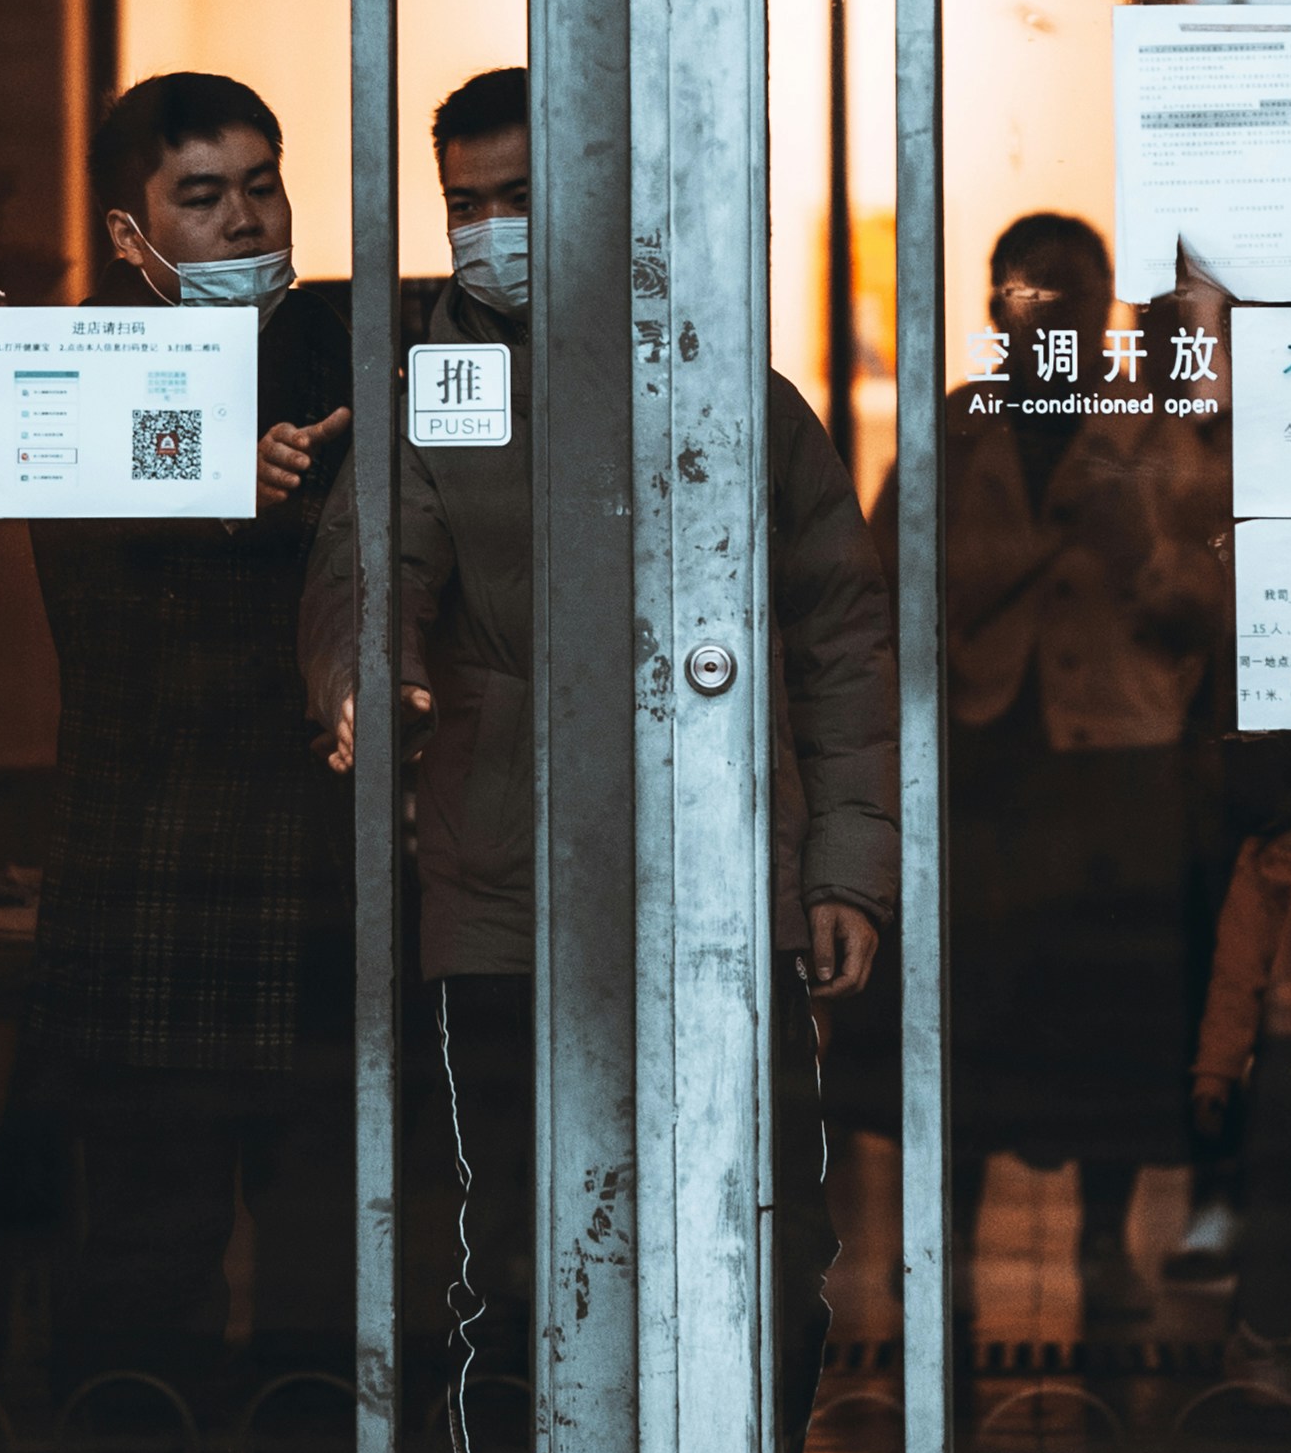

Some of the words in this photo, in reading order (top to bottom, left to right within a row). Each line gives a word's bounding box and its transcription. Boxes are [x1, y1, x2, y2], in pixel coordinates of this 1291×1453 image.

[72, 321, 146, 336] 进店请扫码
[966, 326, 1219, 383] 空调开放
[436, 359, 482, 405] 推
[968, 393, 1154, 415] Air-conditioned
[1164, 398, 1219, 418] open
[430, 418, 491, 435] PUSH
[1265, 588, 1289, 602] 我司
